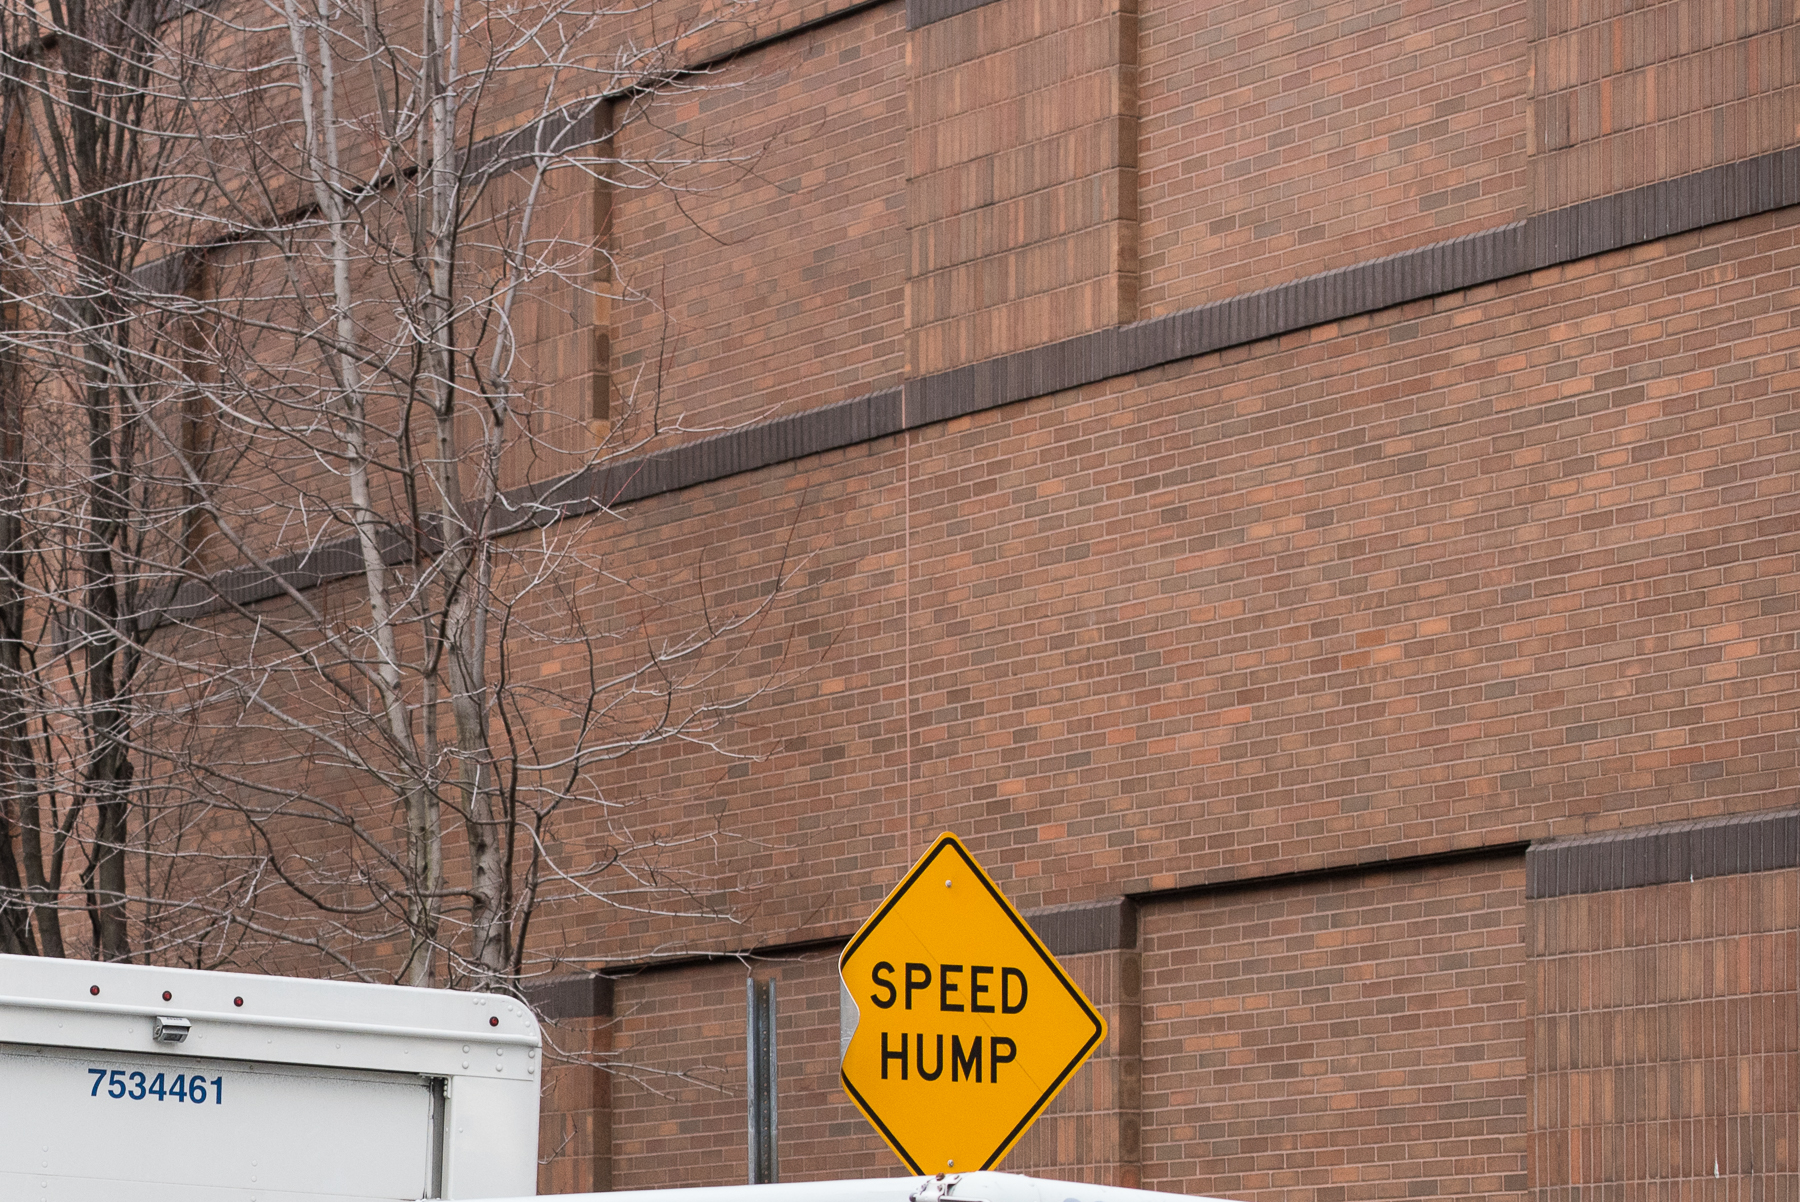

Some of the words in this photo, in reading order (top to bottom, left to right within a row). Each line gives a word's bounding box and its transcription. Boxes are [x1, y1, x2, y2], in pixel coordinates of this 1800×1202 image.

[870, 961, 1028, 1014] SPEED
[880, 1032, 1017, 1084] HUMP
[87, 1068, 223, 1105] 7534461
